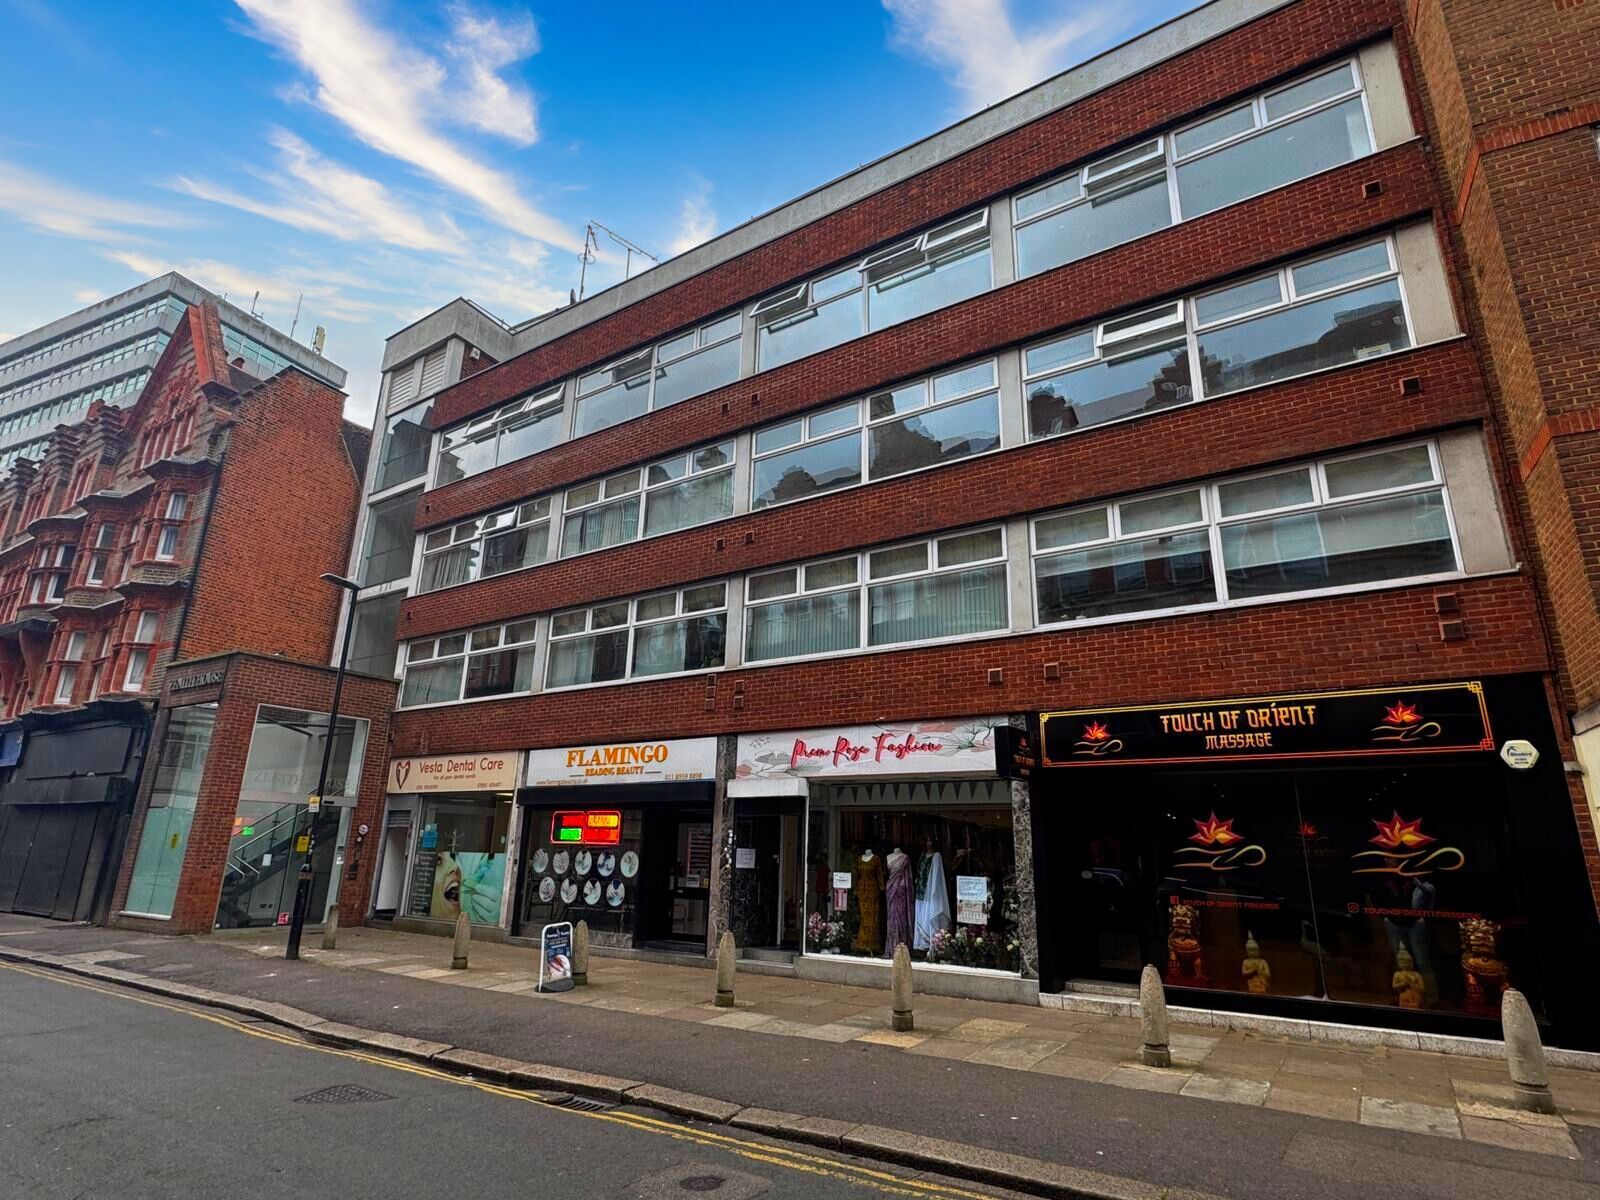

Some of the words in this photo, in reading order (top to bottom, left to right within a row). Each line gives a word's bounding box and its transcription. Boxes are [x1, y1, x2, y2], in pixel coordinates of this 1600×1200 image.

[1160, 712, 1215, 733] TOUCH
[1218, 710, 1240, 730] OF
[790, 738, 831, 769] Prem
[832, 736, 870, 767] Rose
[872, 732, 943, 763] Fashion
[1205, 732, 1272, 750] MASSAGE
[420, 761, 442, 773] Vesta
[447, 758, 476, 772] Dental
[480, 757, 504, 771] Care
[566, 744, 668, 767] FLAMINGO
[585, 767, 615, 777] READING
[616, 766, 644, 775] BEAUTY
